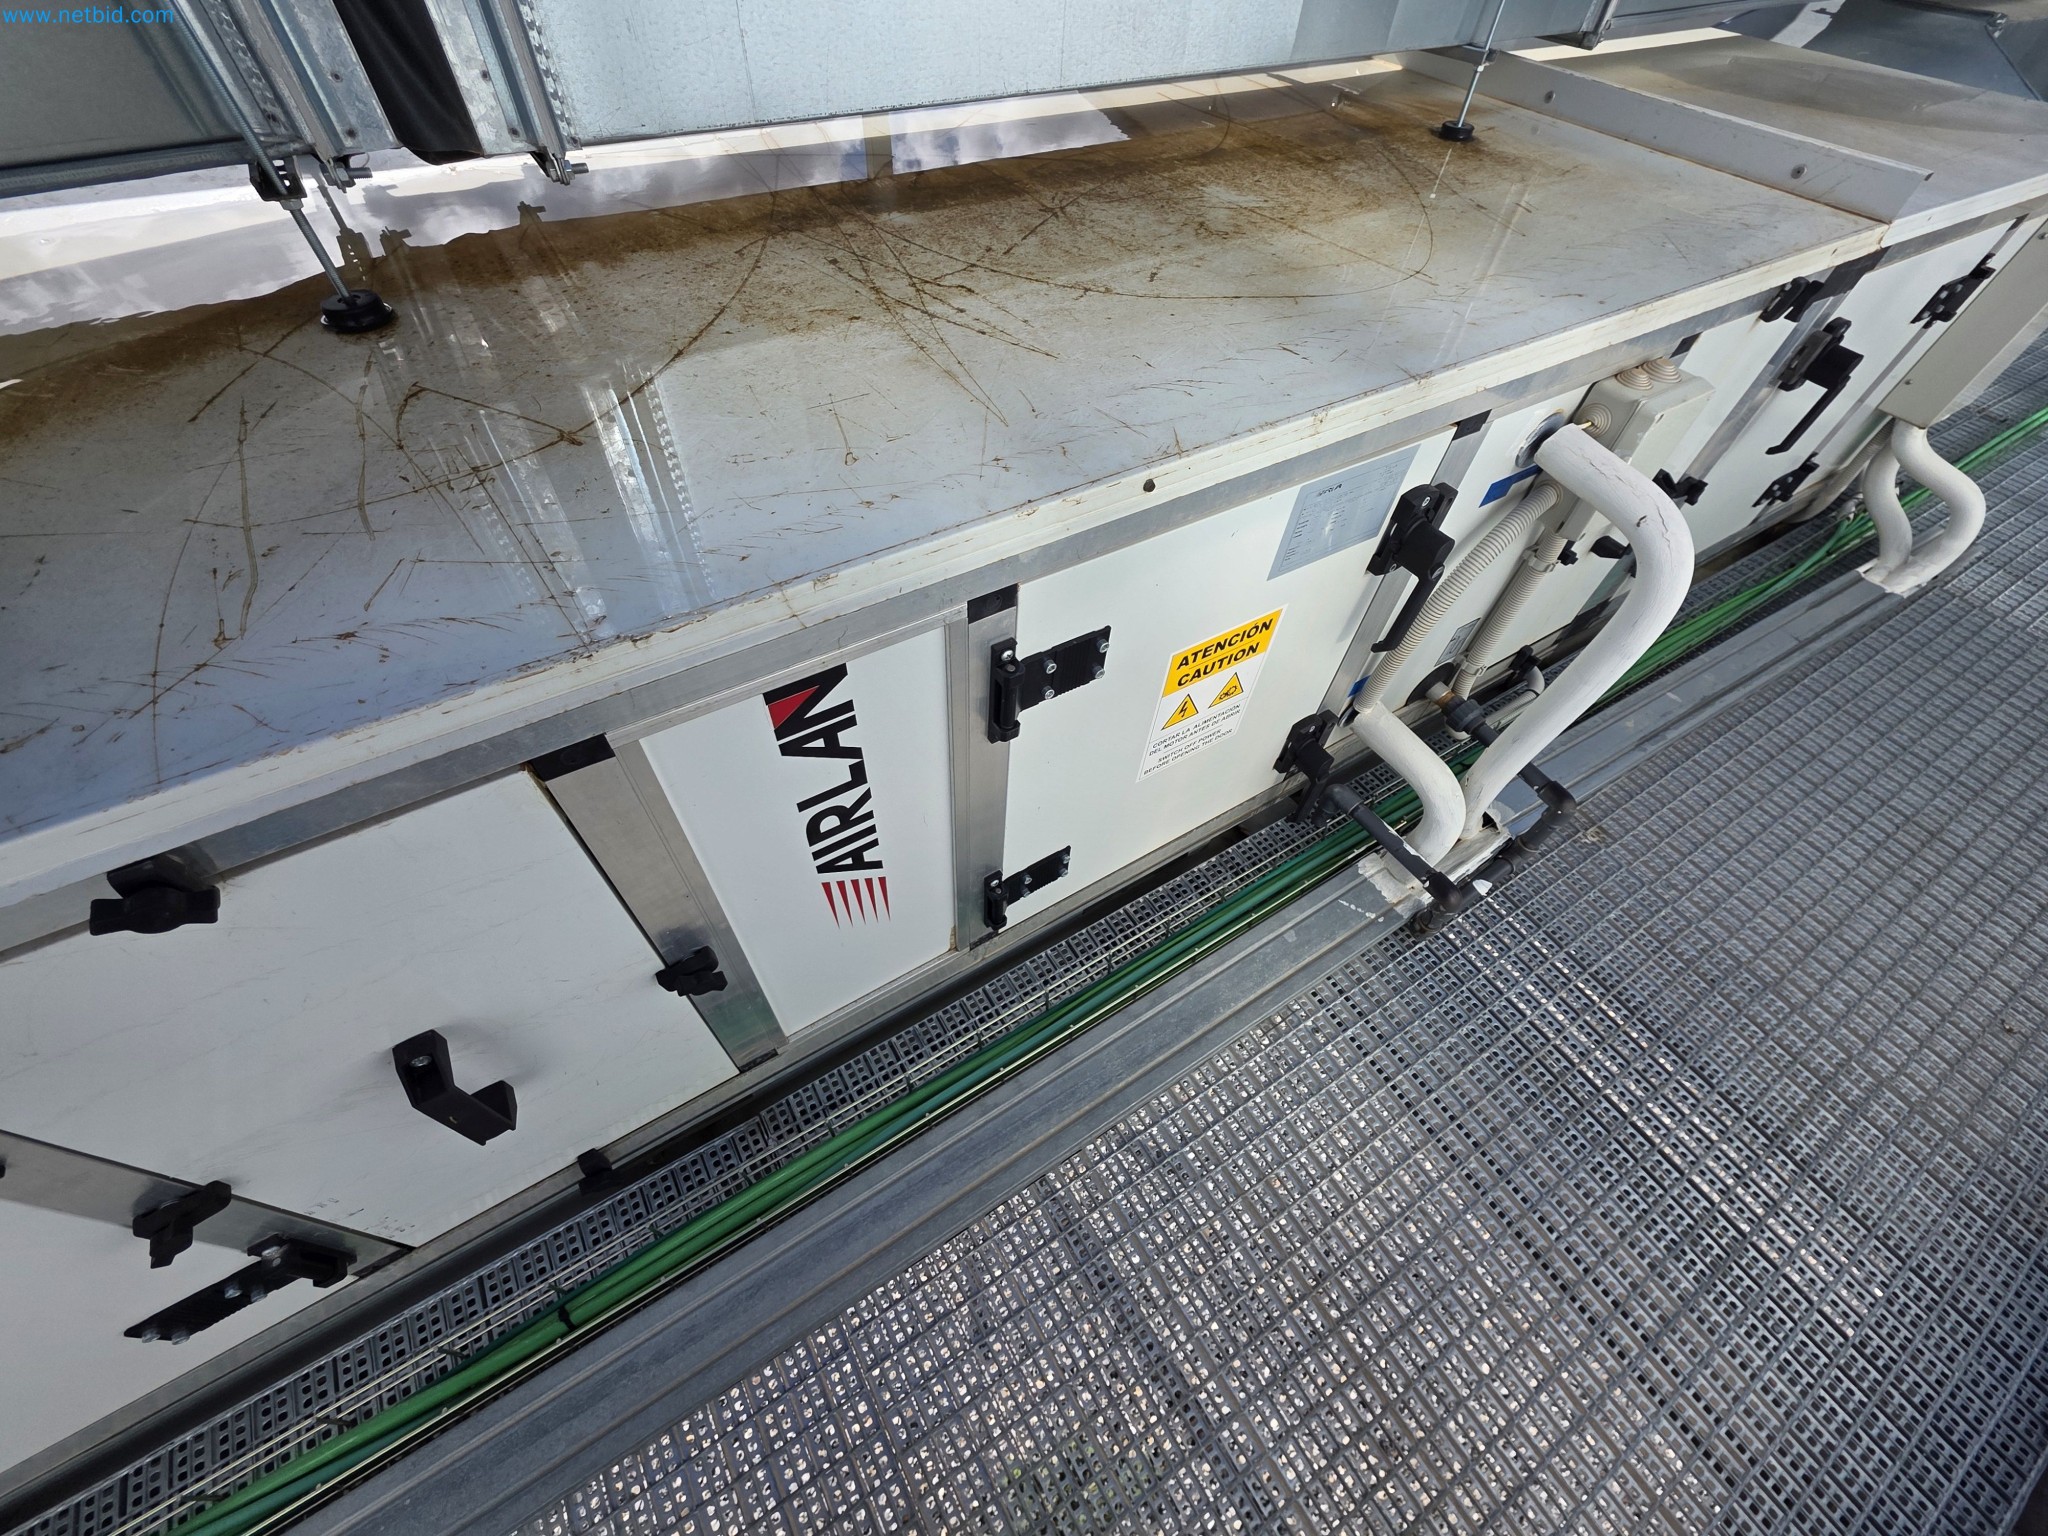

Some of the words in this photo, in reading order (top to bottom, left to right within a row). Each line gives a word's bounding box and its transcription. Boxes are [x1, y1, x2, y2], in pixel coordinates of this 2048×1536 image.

[1176, 618, 1274, 671] ATENCIÓN
[1177, 641, 1261, 687] CAUTION
[1143, 758, 1170, 776] BEFORE
[1171, 744, 1200, 762] OPENING
[1201, 737, 1214, 747] THE
[1214, 728, 1233, 741] DOOR
[1149, 747, 1161, 757] DEL
[1163, 734, 1188, 750] MOTOR
[1188, 723, 1210, 738] ANTES
[1211, 718, 1221, 727] DE
[1220, 709, 1241, 723] ABRIR
[1152, 732, 1181, 749] CORTAR
[1181, 727, 1191, 737] LA
[1157, 747, 1184, 763] SWITCH
[1184, 740, 1198, 750] OFF
[1197, 728, 1222, 744] POWER
[762, 662, 884, 875] AIRLAN
